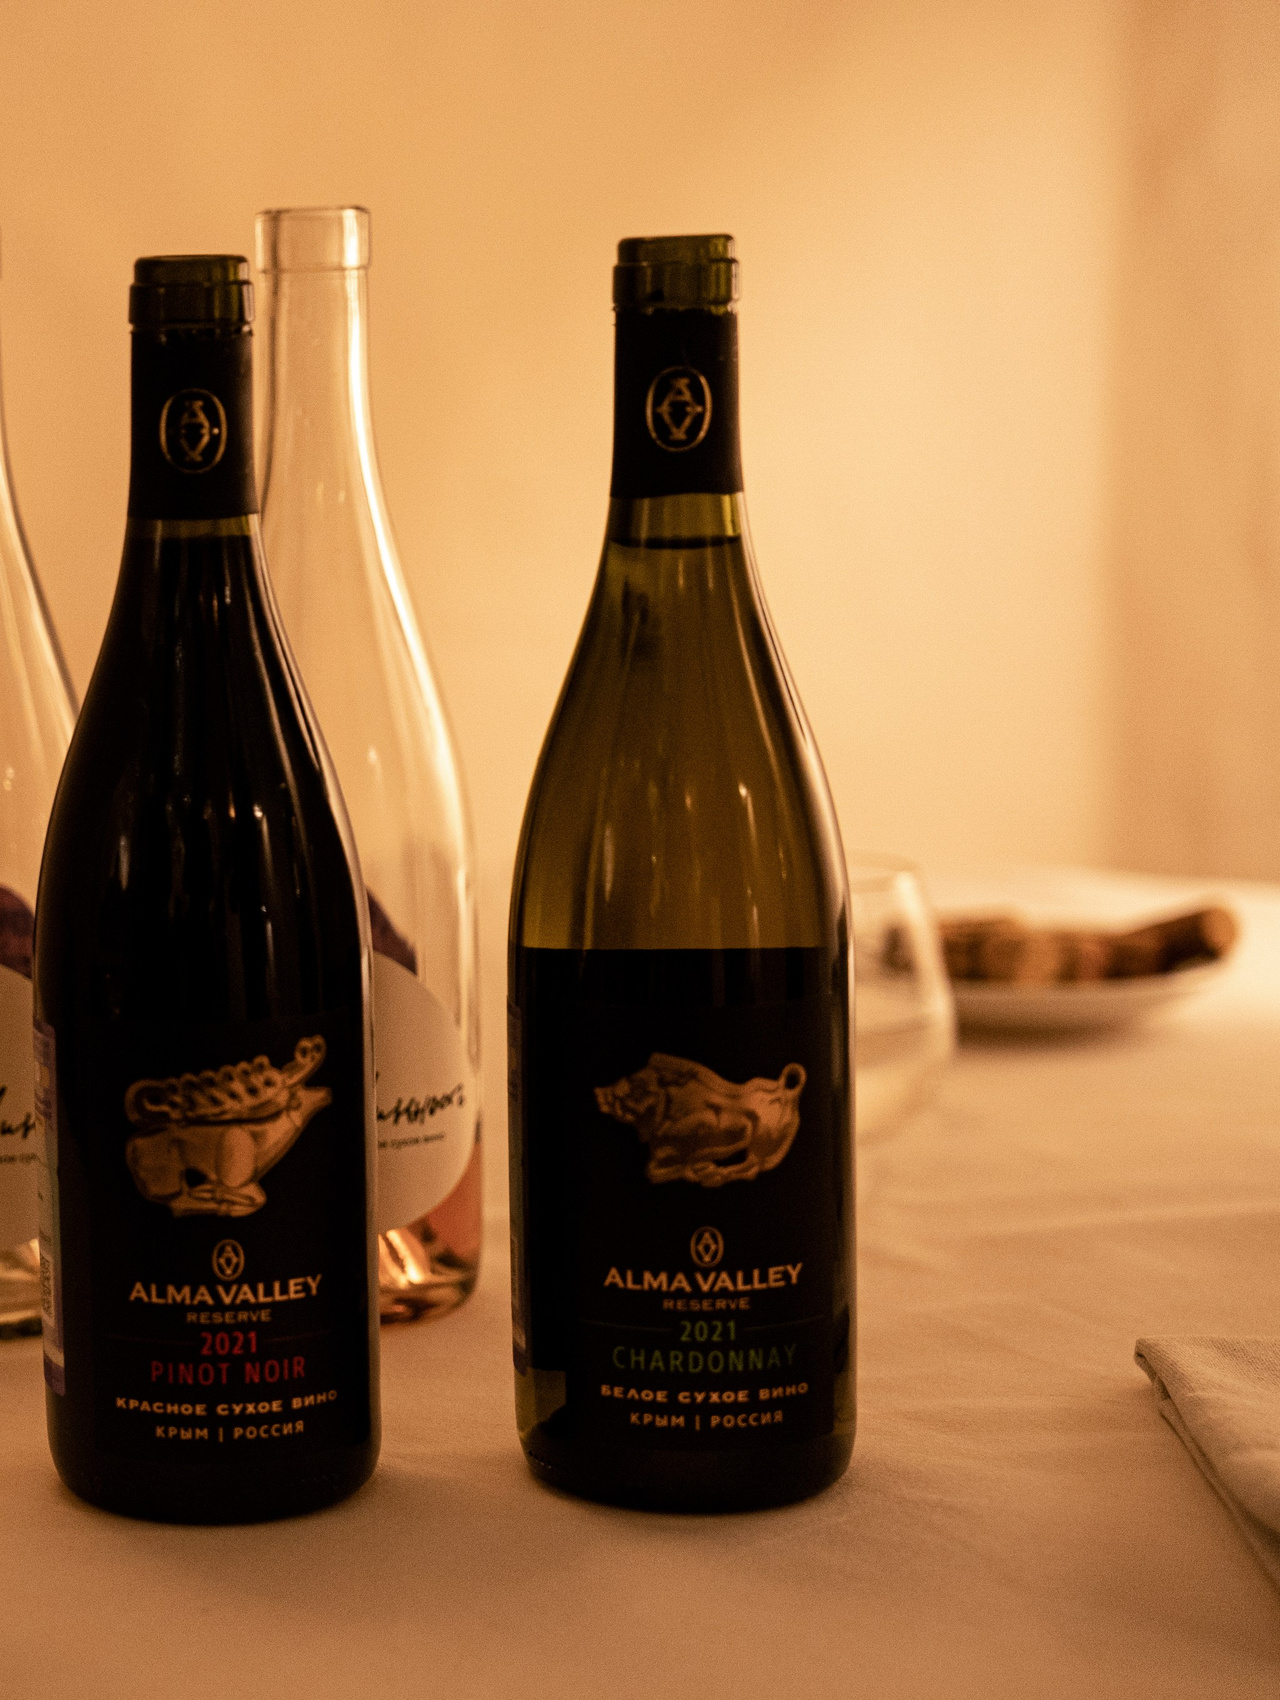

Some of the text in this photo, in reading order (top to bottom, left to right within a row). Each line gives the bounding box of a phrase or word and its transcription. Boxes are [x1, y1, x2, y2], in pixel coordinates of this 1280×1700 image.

[604, 1262, 803, 1293] ALMA VALLEY
[129, 1273, 322, 1306] ALMA VALLEY
[662, 1297, 751, 1312] RESERVE
[186, 1309, 272, 1325] RESERVE
[680, 1320, 735, 1342] 2021
[202, 1331, 256, 1355] 2021
[151, 1356, 305, 1385] PINOT NOIR
[612, 1344, 797, 1374] CHARDONNAY
[116, 1391, 336, 1415] КРАСНОЕ СУХОЕ ВИНО
[601, 1383, 808, 1403] БЕЛОЕ СУХОЕ ВИНО
[156, 1426, 208, 1440] КРЫМ
[233, 1420, 304, 1439] РОССИЯ
[630, 1413, 685, 1427] КРЫМ
[710, 1410, 783, 1428] РОССИЯ
